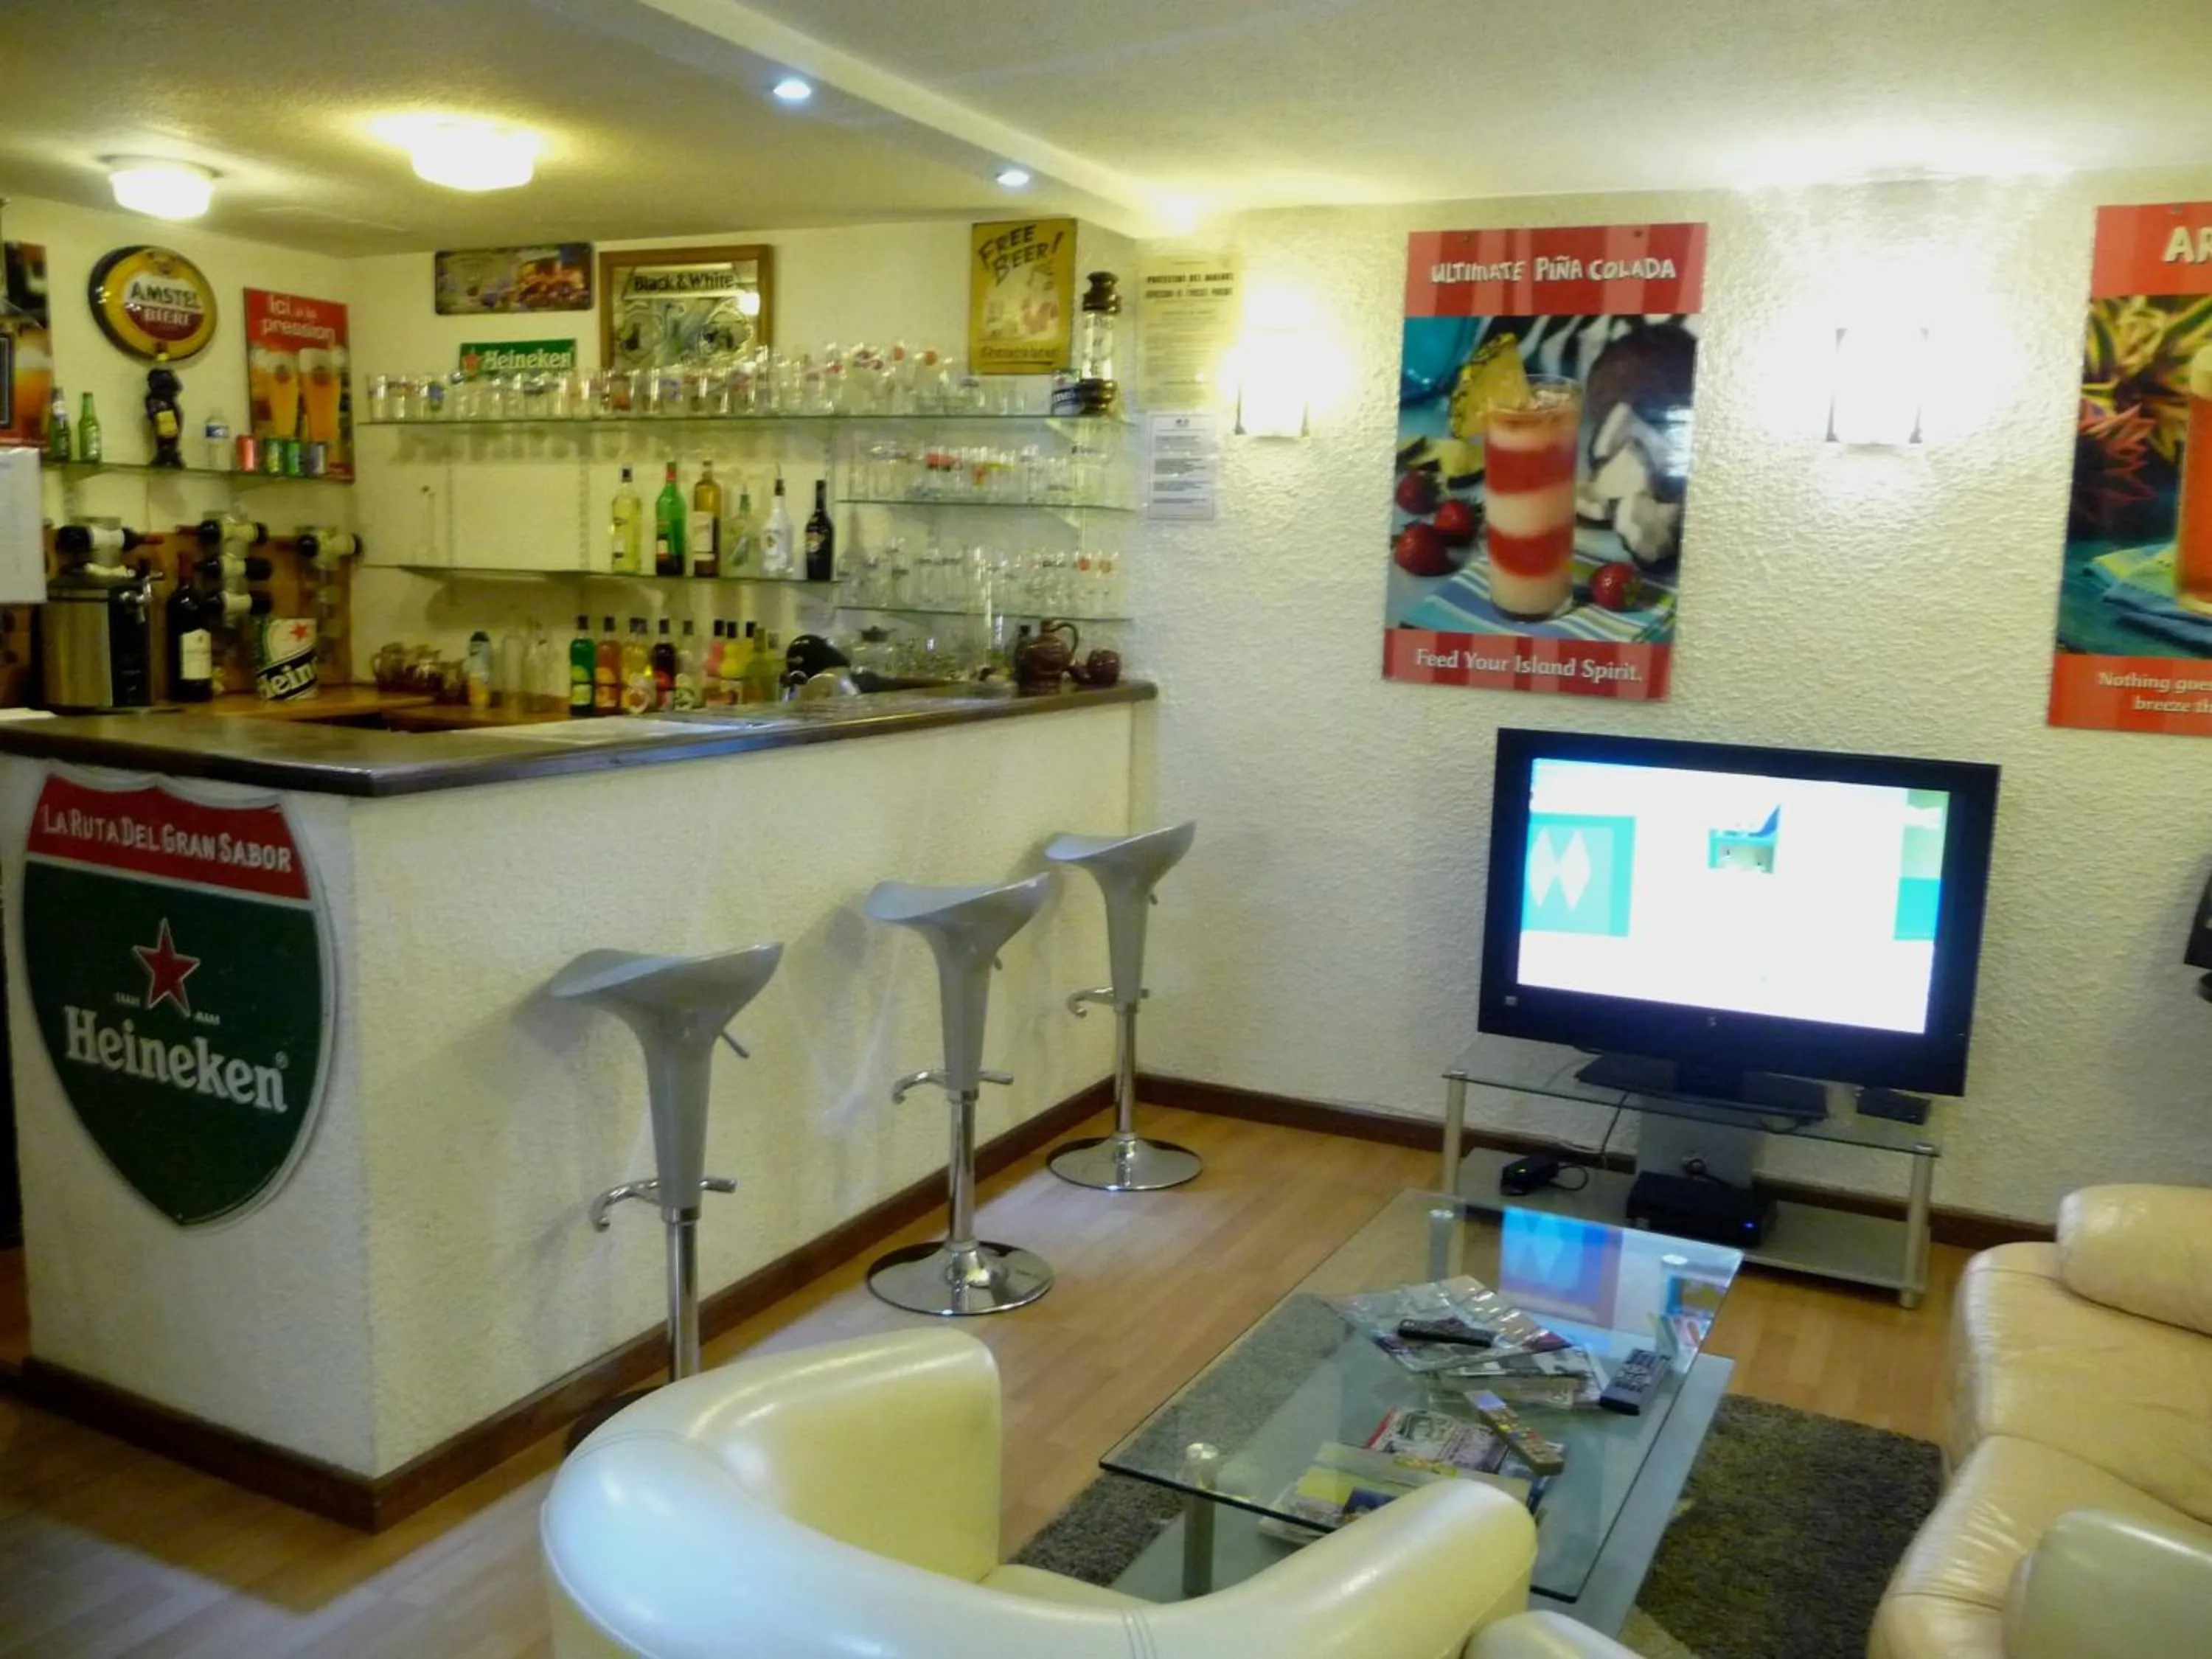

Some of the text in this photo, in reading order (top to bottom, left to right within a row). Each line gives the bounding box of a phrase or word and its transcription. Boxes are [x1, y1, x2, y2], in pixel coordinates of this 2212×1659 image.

[978, 223, 1037, 272] FREE
[992, 230, 1065, 288] BEER!
[633, 271, 734, 291] Black & White
[1430, 255, 1677, 283] ULTIMATE PIÑA COLADA
[131, 281, 201, 310] AMSTEL
[268, 293, 290, 316] Ici
[261, 318, 335, 341] pression
[481, 348, 572, 370] Heineken
[1416, 648, 1643, 684] Feed Your Island Spirit.
[2098, 672, 2171, 692] Nothing
[2134, 695, 2192, 712] breeze
[41, 804, 293, 874] LA RUTA DEL GRAN SABOR
[63, 1004, 288, 1114] Heineken
